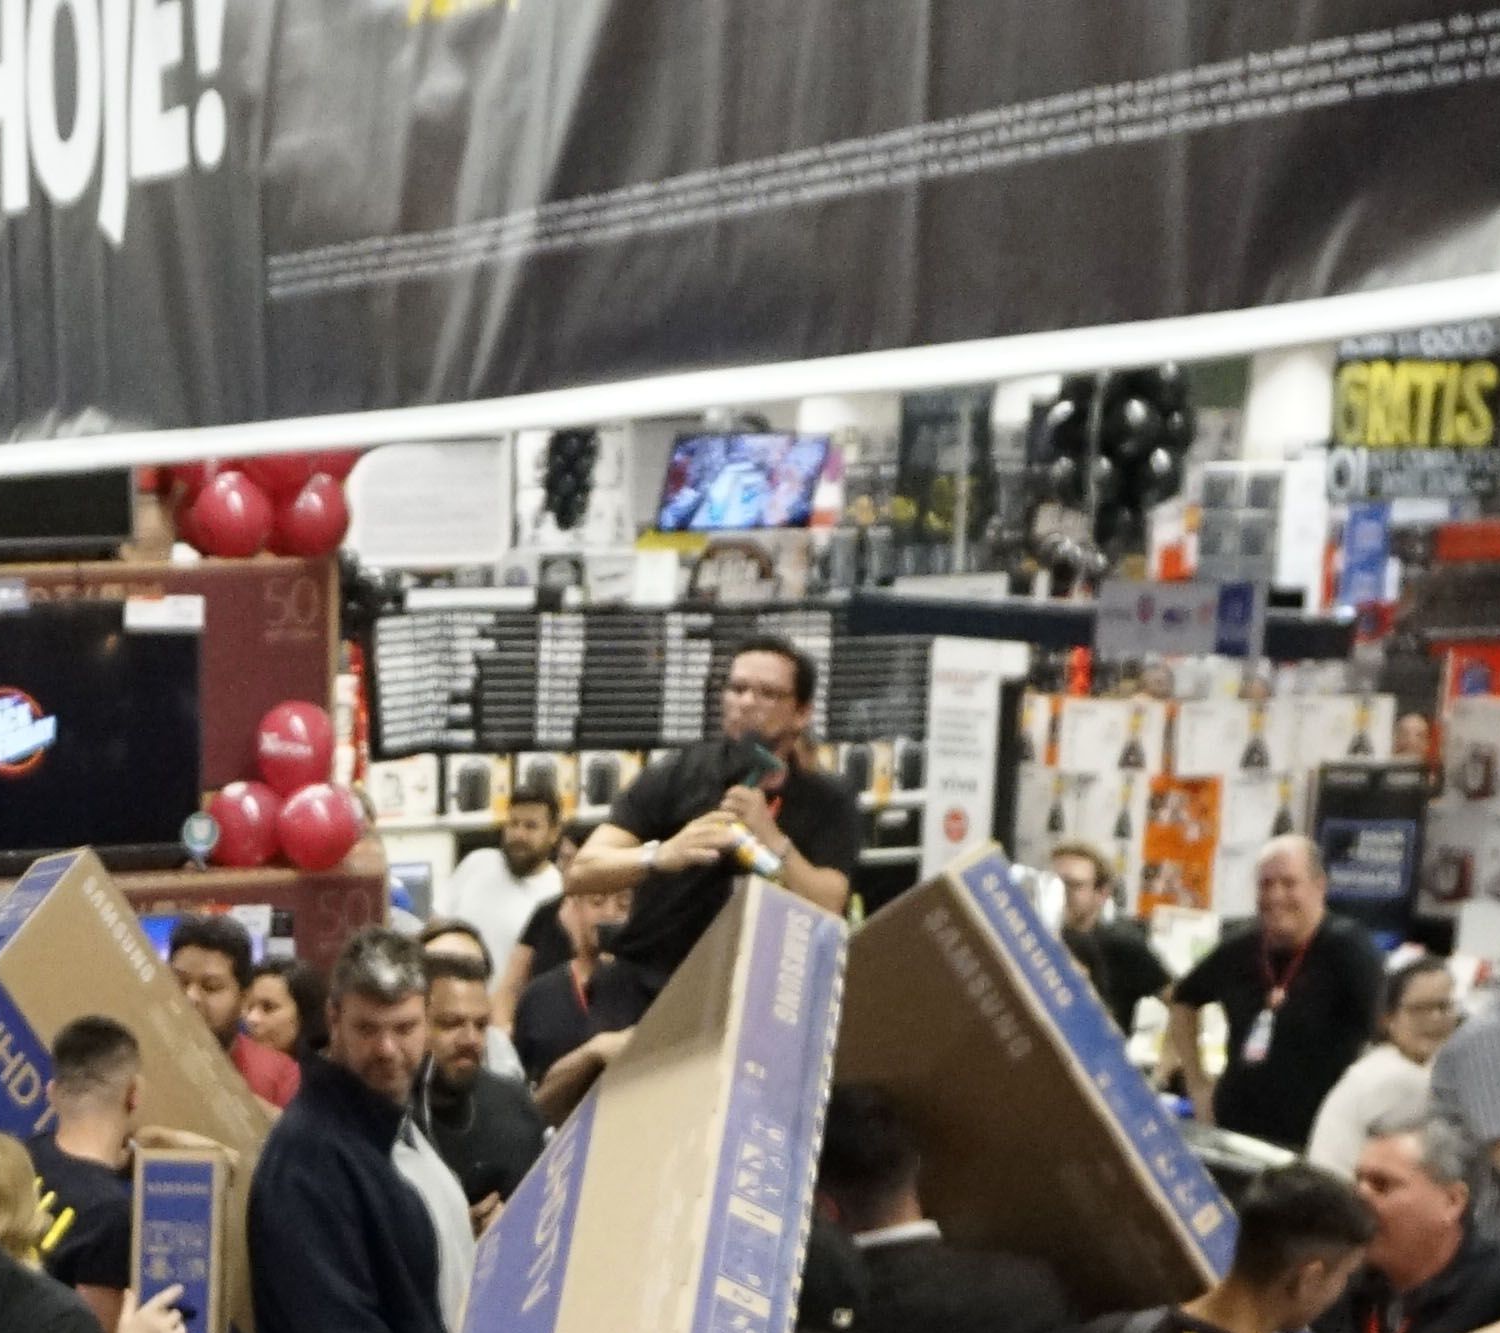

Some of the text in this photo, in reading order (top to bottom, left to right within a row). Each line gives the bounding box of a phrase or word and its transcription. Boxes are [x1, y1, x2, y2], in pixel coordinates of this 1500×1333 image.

[80, 875, 155, 985] SAMSUNG
[774, 908, 816, 1028] SAMSUNG
[925, 904, 1034, 1062] SAMSUNG
[982, 872, 1074, 1012] SAMSUNG
